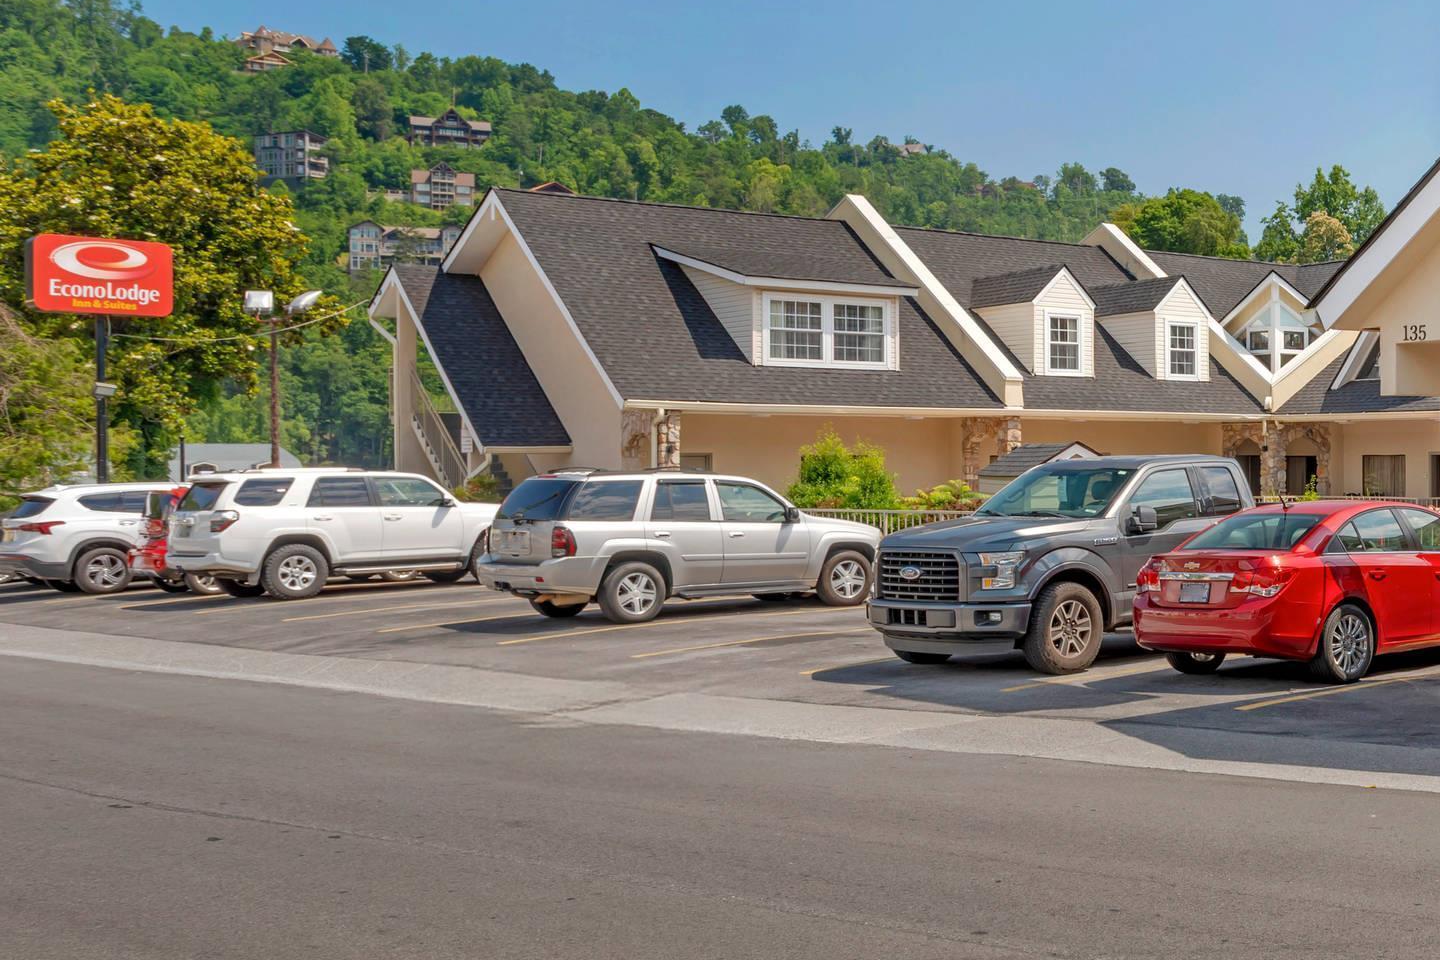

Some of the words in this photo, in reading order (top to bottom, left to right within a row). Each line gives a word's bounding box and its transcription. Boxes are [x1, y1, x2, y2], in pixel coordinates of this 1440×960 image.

[72, 299, 91, 308] Inn
[93, 300, 101, 308] &
[104, 301, 137, 310] Suites
[1403, 324, 1427, 341] 135
